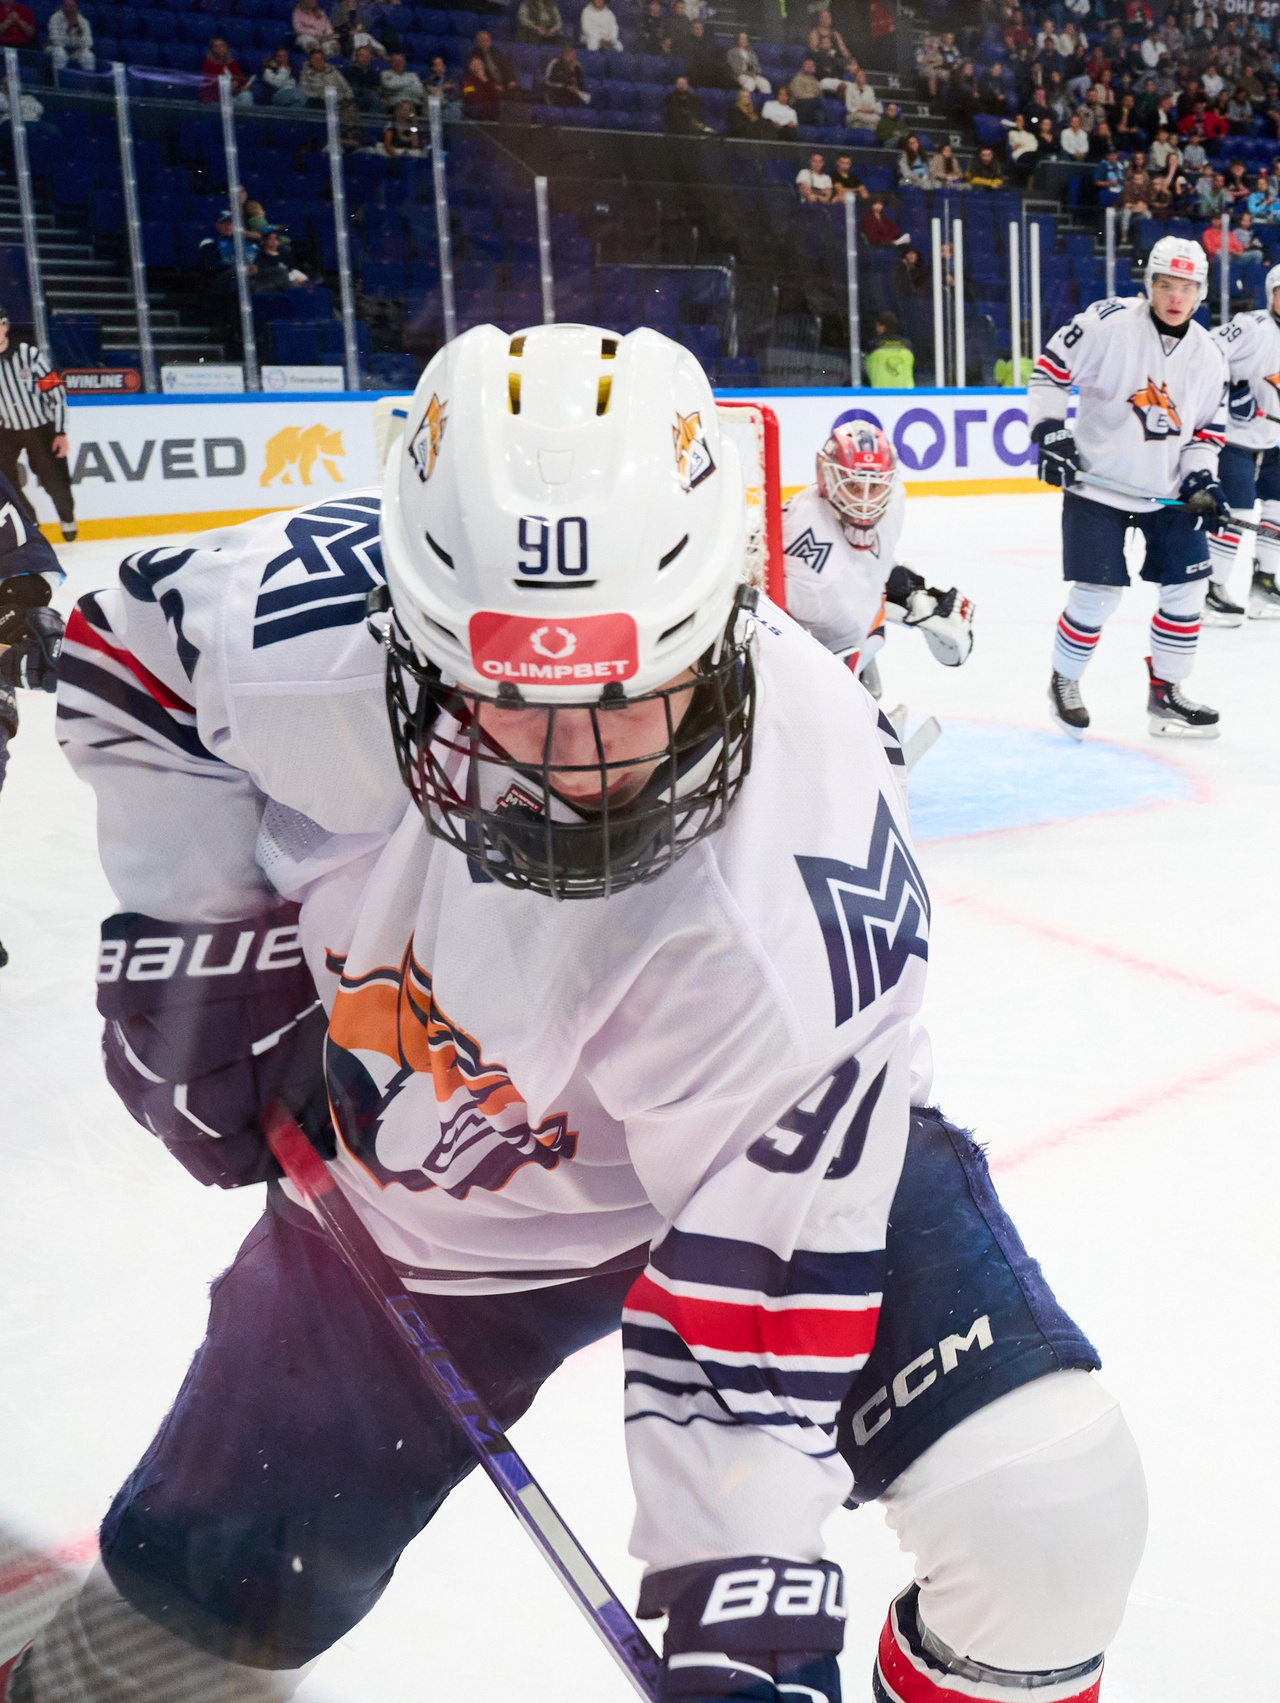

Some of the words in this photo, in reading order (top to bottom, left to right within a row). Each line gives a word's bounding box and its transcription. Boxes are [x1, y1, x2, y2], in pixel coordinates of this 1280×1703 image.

[66, 374, 123, 389] WINLINE
[517, 515, 588, 576] 90
[482, 659, 630, 680] OLIMPBET
[852, 1316, 993, 1446] CCM
